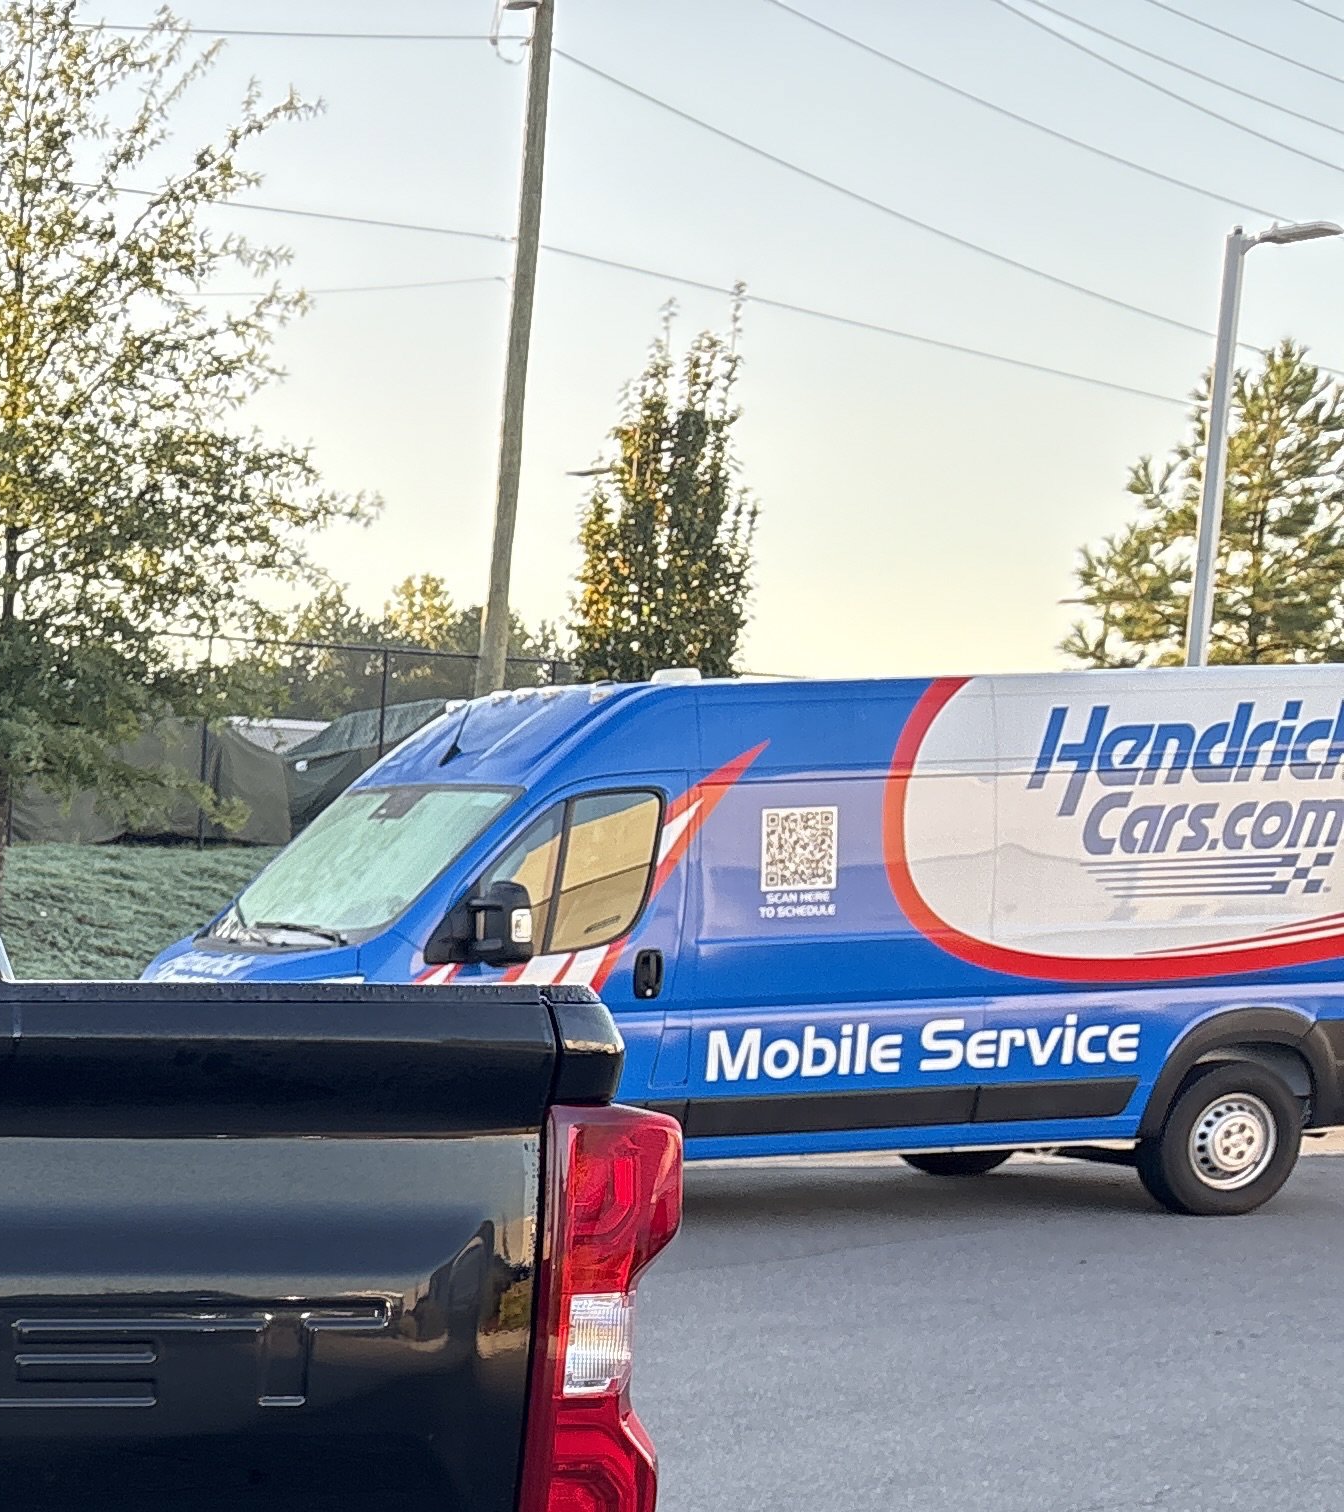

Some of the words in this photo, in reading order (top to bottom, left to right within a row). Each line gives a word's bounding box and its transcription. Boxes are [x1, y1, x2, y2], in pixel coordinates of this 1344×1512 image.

[1082, 791, 1344, 855] Cars.com
[759, 907, 775, 918] TO
[776, 904, 836, 917] SCHEDULE
[766, 893, 798, 904] SCAN
[799, 891, 830, 902] HERE
[705, 1023, 903, 1082] Mobile
[919, 1013, 1141, 1071] Service
